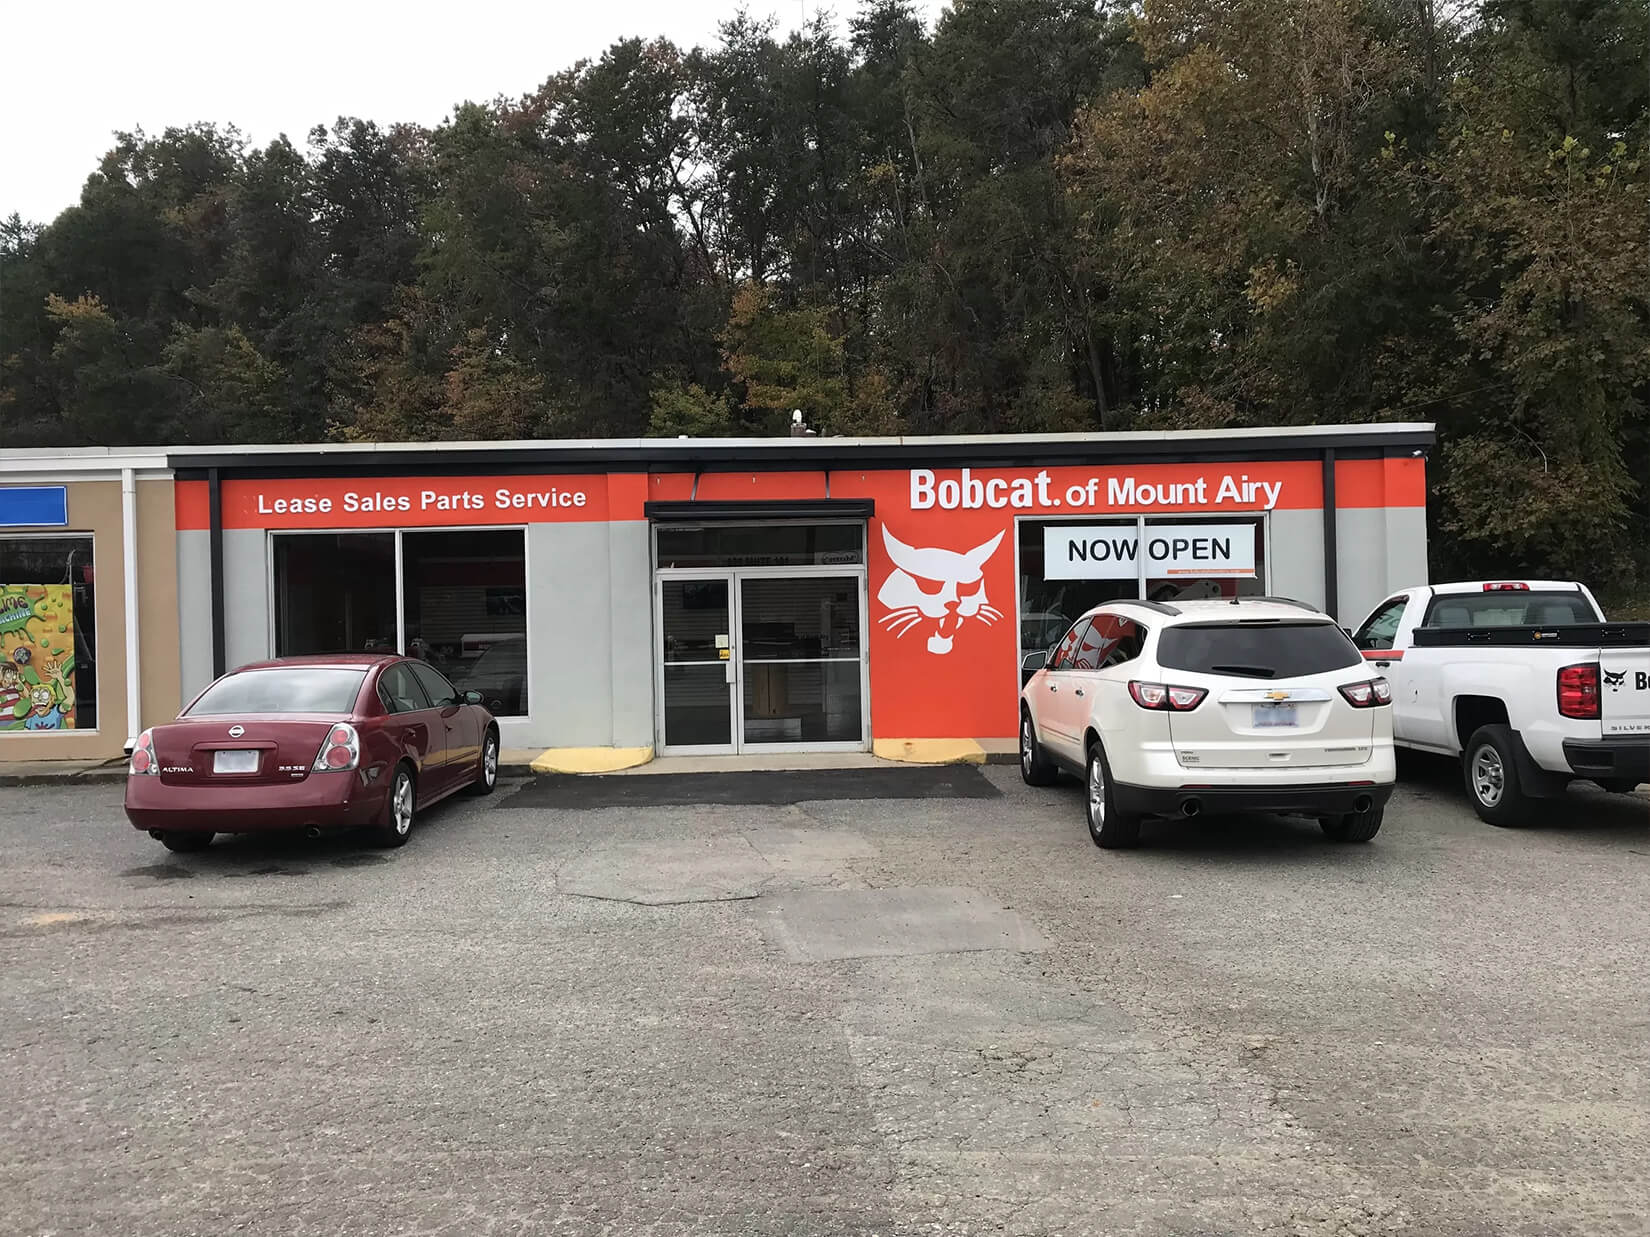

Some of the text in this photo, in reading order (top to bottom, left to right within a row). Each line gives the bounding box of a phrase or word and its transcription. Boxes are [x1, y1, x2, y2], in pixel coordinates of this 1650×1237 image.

[258, 487, 587, 514] Lease Sales Parts Service
[1065, 478, 1099, 507] of
[1107, 477, 1208, 505] Mount
[1215, 475, 1282, 510] Airy
[1068, 537, 1231, 561] NOW OPEN
[1635, 671, 1650, 691] B
